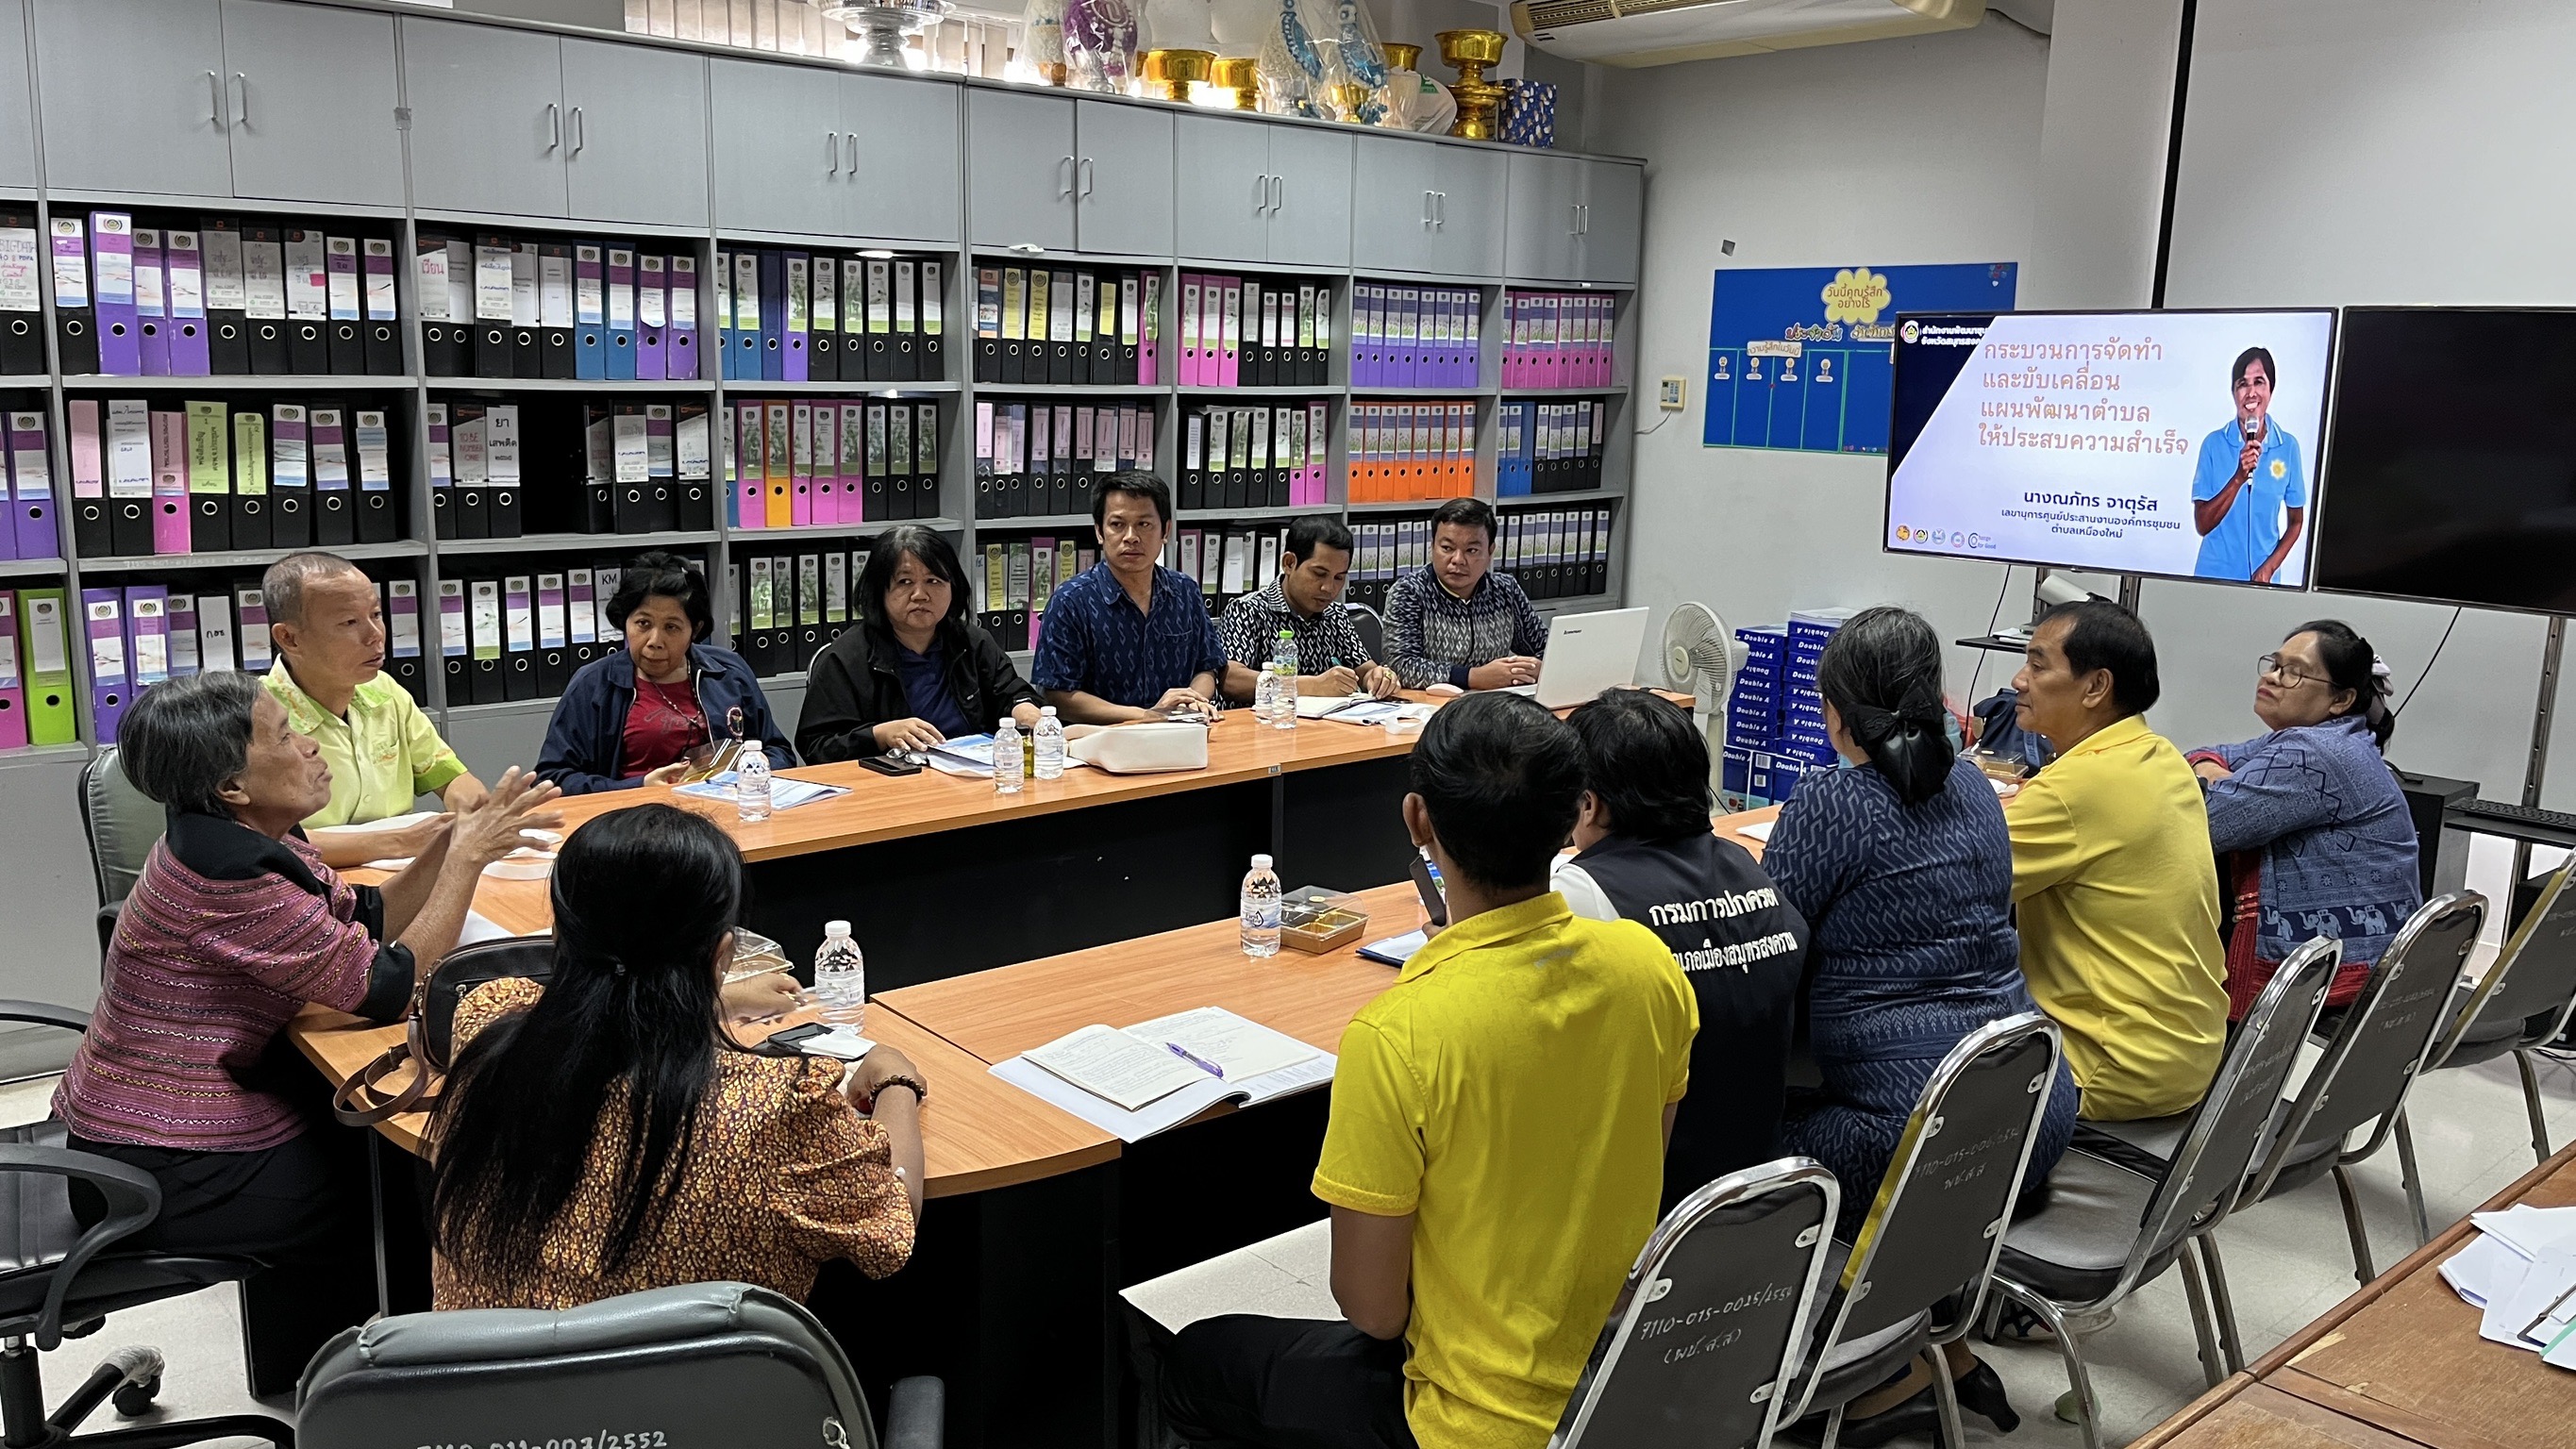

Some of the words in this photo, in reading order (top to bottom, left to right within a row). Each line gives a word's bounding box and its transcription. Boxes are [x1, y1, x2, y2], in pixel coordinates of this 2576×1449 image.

[1984, 337, 2163, 360] กระบวนการจัดทำ
[1982, 360, 2120, 391] และขับเคลื่อน
[1981, 395, 2150, 422] แผนพัฒนาตำบล
[1978, 422, 2189, 455] ให้ประสบความสำเร็จ
[2024, 491, 2099, 508] นางณภัทร
[2107, 495, 2158, 514] จาตุรัส
[2051, 524, 2123, 539] ตำบลเหมืองใหม่
[1744, 633, 1768, 643] Double
[1804, 628, 1830, 638] Double
[1797, 657, 1818, 666] Doubl
[1746, 666, 1769, 675] Double
[1739, 677, 1764, 687] Double
[1739, 691, 1763, 702] Double
[1736, 706, 1760, 716] Double
[1736, 721, 1760, 731] Double
[1800, 720, 1826, 730] Double
[1735, 736, 1760, 745] Double
[1798, 735, 1824, 745] Double
[1723, 751, 1746, 761] Double
[1792, 749, 1815, 760] Double
[1775, 761, 1799, 773] Double
